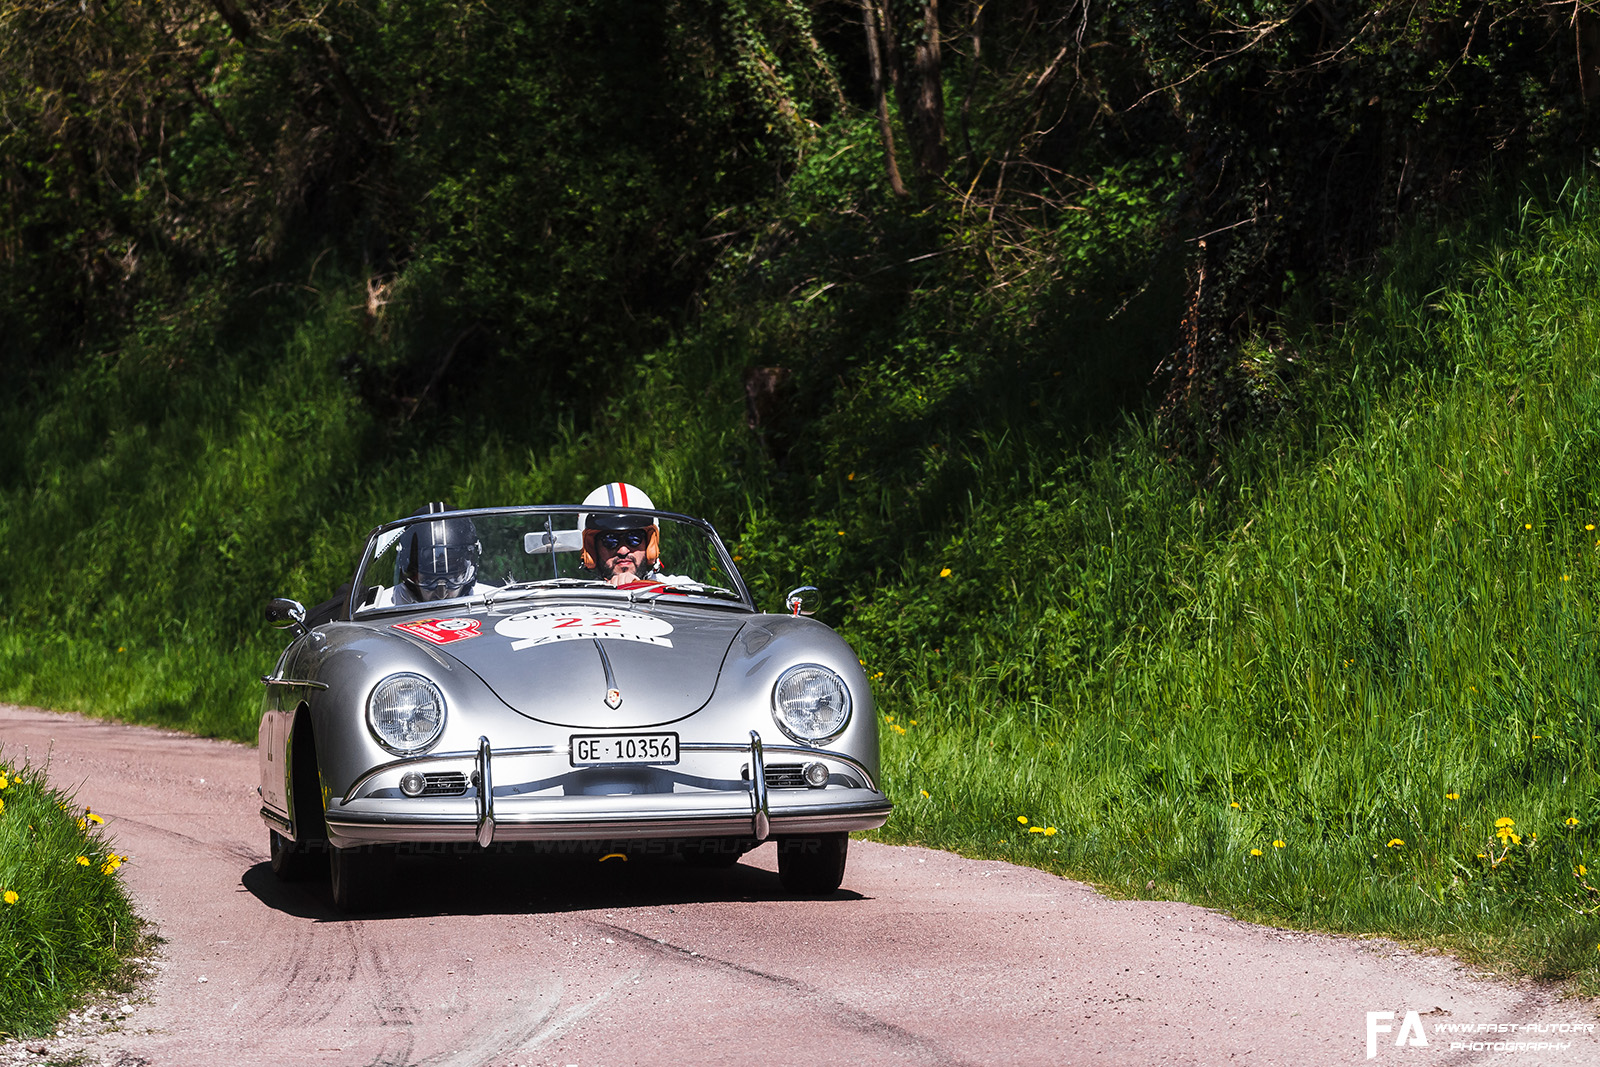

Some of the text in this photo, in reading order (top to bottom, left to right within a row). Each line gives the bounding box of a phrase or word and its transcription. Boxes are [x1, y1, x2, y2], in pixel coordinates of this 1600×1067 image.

[552, 617, 621, 629] 22
[533, 632, 655, 644] ZENITH
[615, 738, 671, 759] 10356
